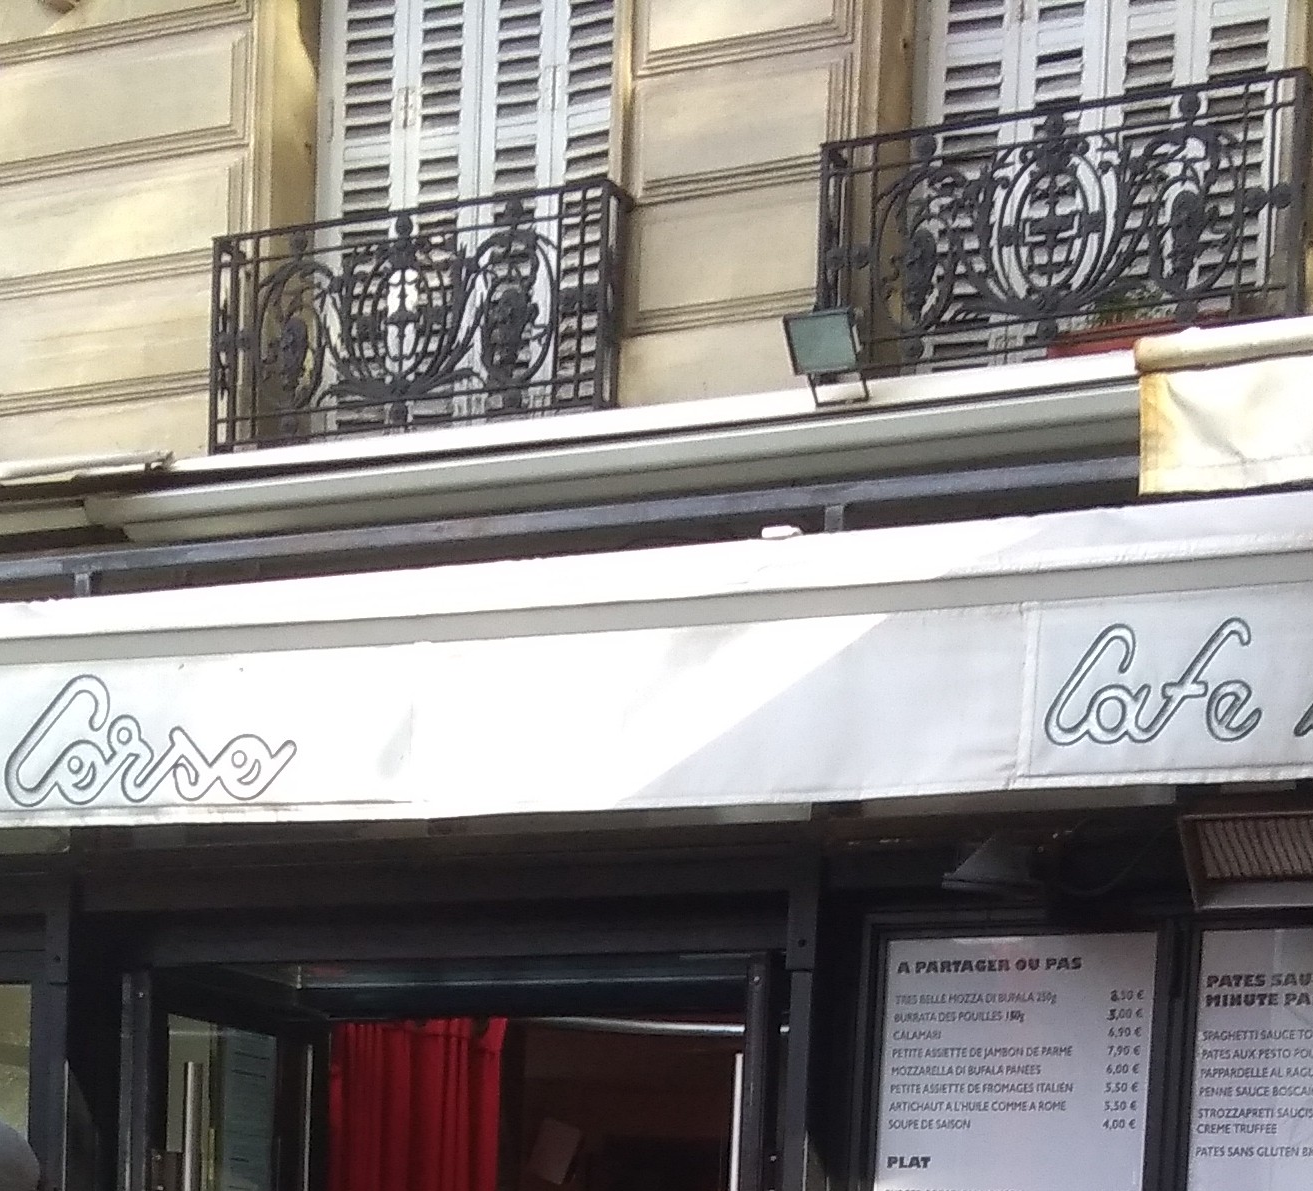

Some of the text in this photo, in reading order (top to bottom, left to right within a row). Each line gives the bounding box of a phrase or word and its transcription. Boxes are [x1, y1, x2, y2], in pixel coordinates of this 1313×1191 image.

[4, 674, 298, 807] Corso
[898, 957, 1082, 974] A PARTAGER OU PAS
[1207, 974, 1265, 988] PATES
[887, 1156, 931, 1168] PLAT
